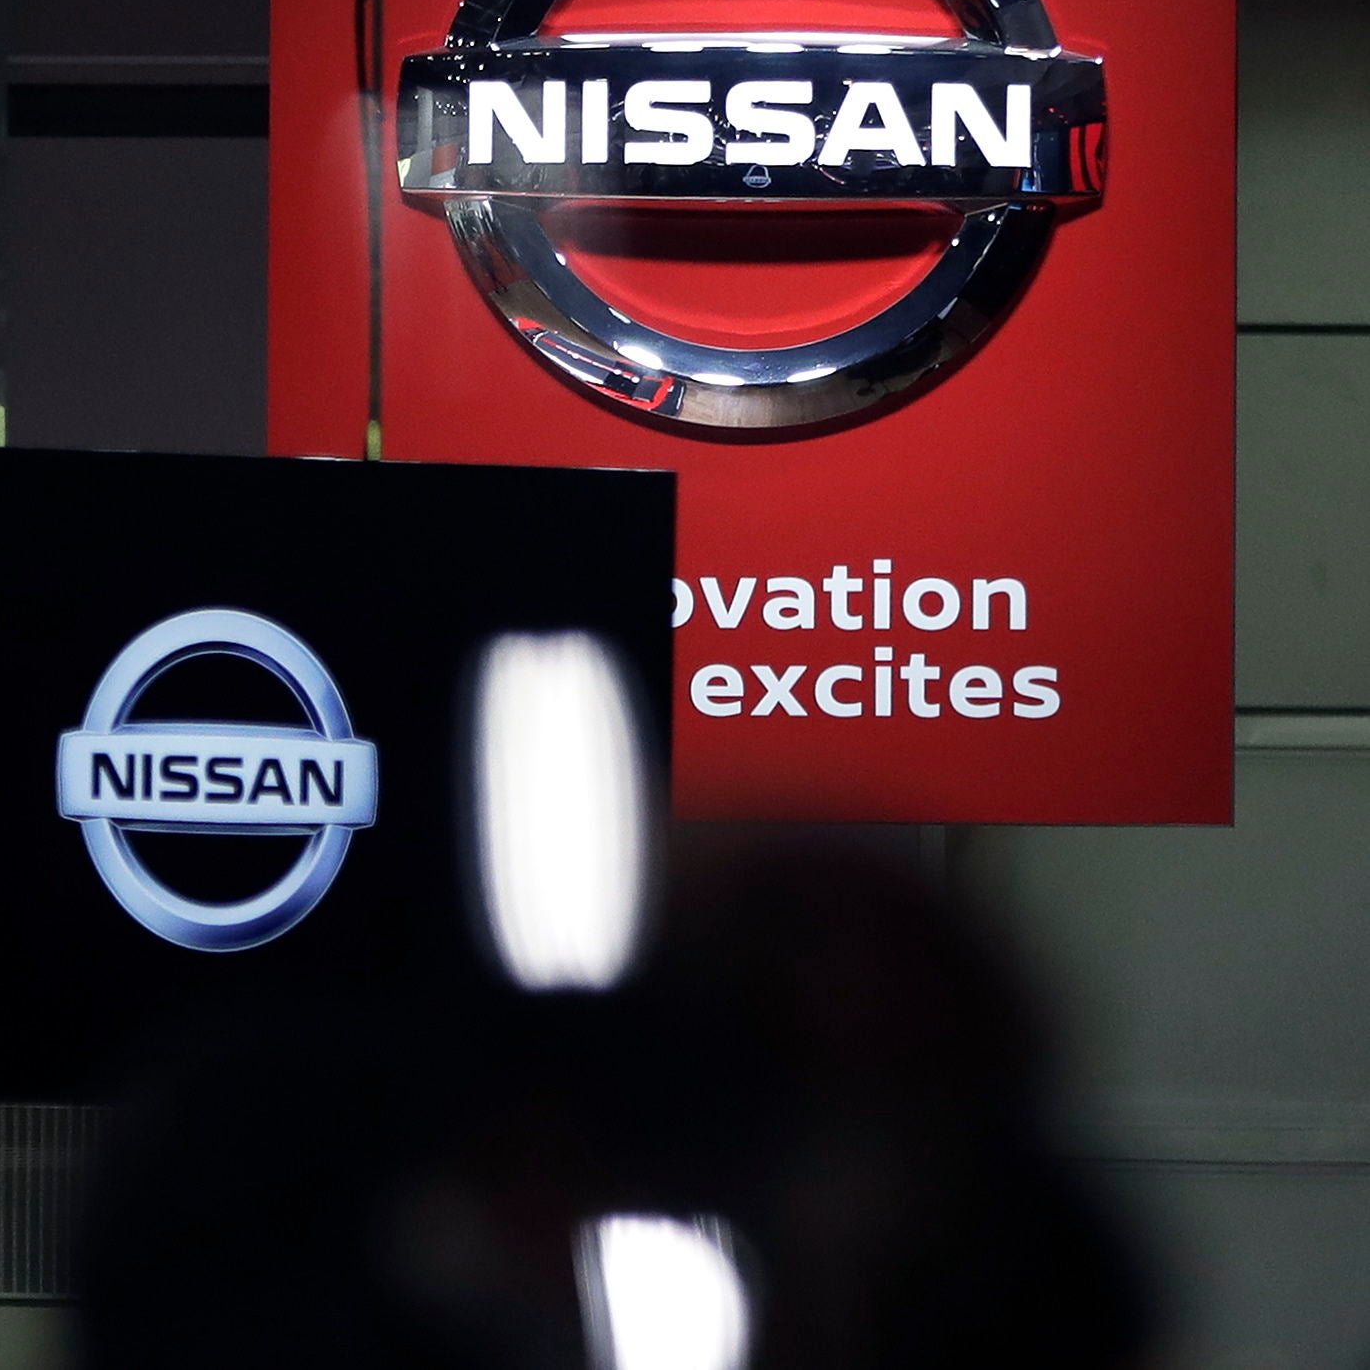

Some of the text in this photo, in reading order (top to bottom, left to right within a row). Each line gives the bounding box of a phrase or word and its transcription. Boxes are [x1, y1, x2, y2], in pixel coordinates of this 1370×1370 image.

[468, 80, 1033, 168] NISSAN
[690, 646, 1061, 720] excites
[90, 752, 344, 808] NISSAN
